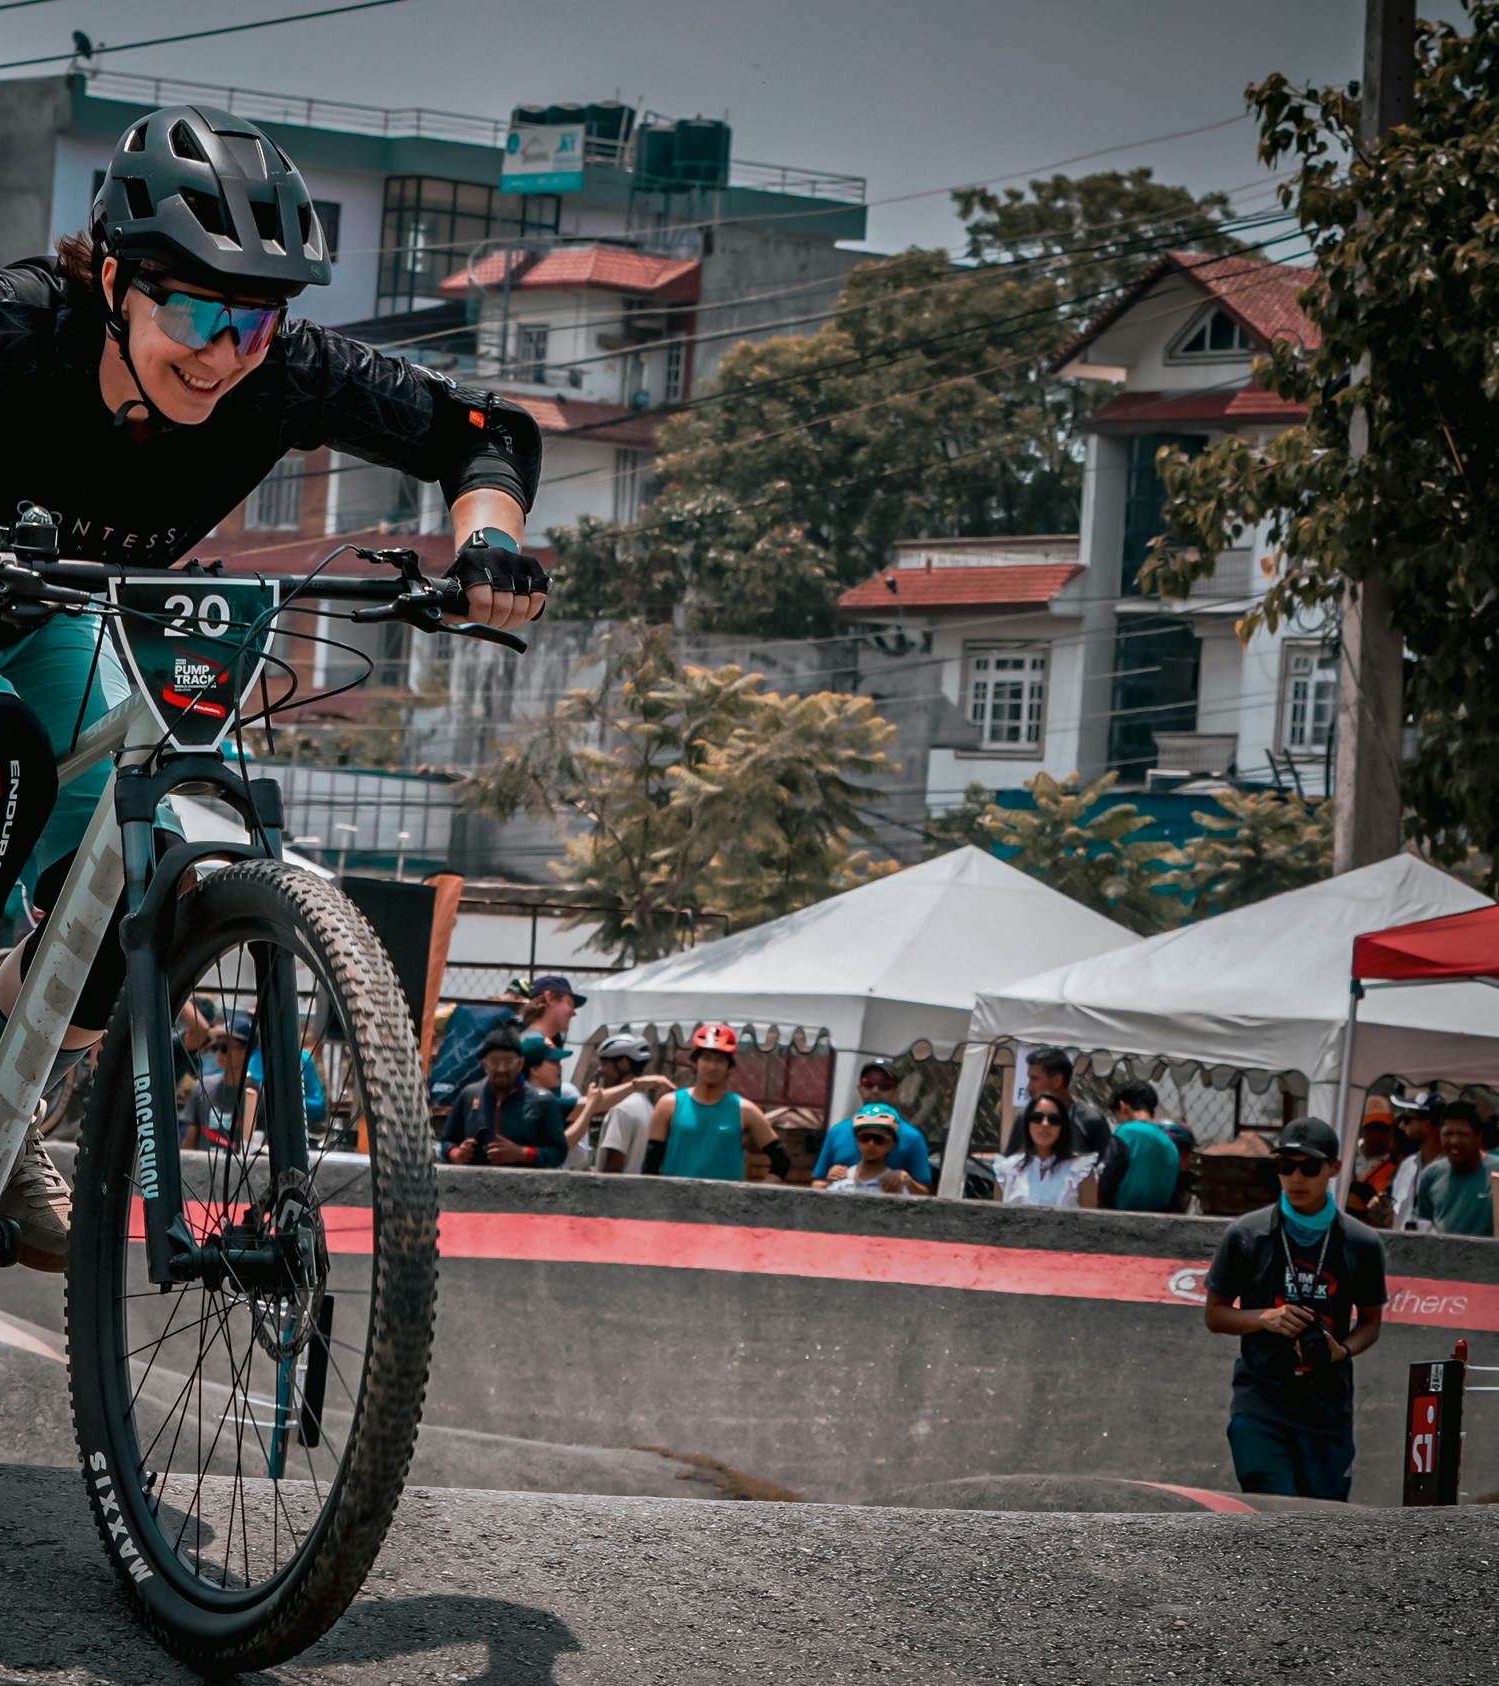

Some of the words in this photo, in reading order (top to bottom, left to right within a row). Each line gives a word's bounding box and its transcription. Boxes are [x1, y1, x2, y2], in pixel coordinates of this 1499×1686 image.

[163, 594, 231, 638] 20
[174, 664, 210, 675] PUMP
[174, 674, 216, 685] TRACK
[133, 1075, 160, 1200] ROCKSHOX
[89, 1451, 155, 1584] MAXXIS
